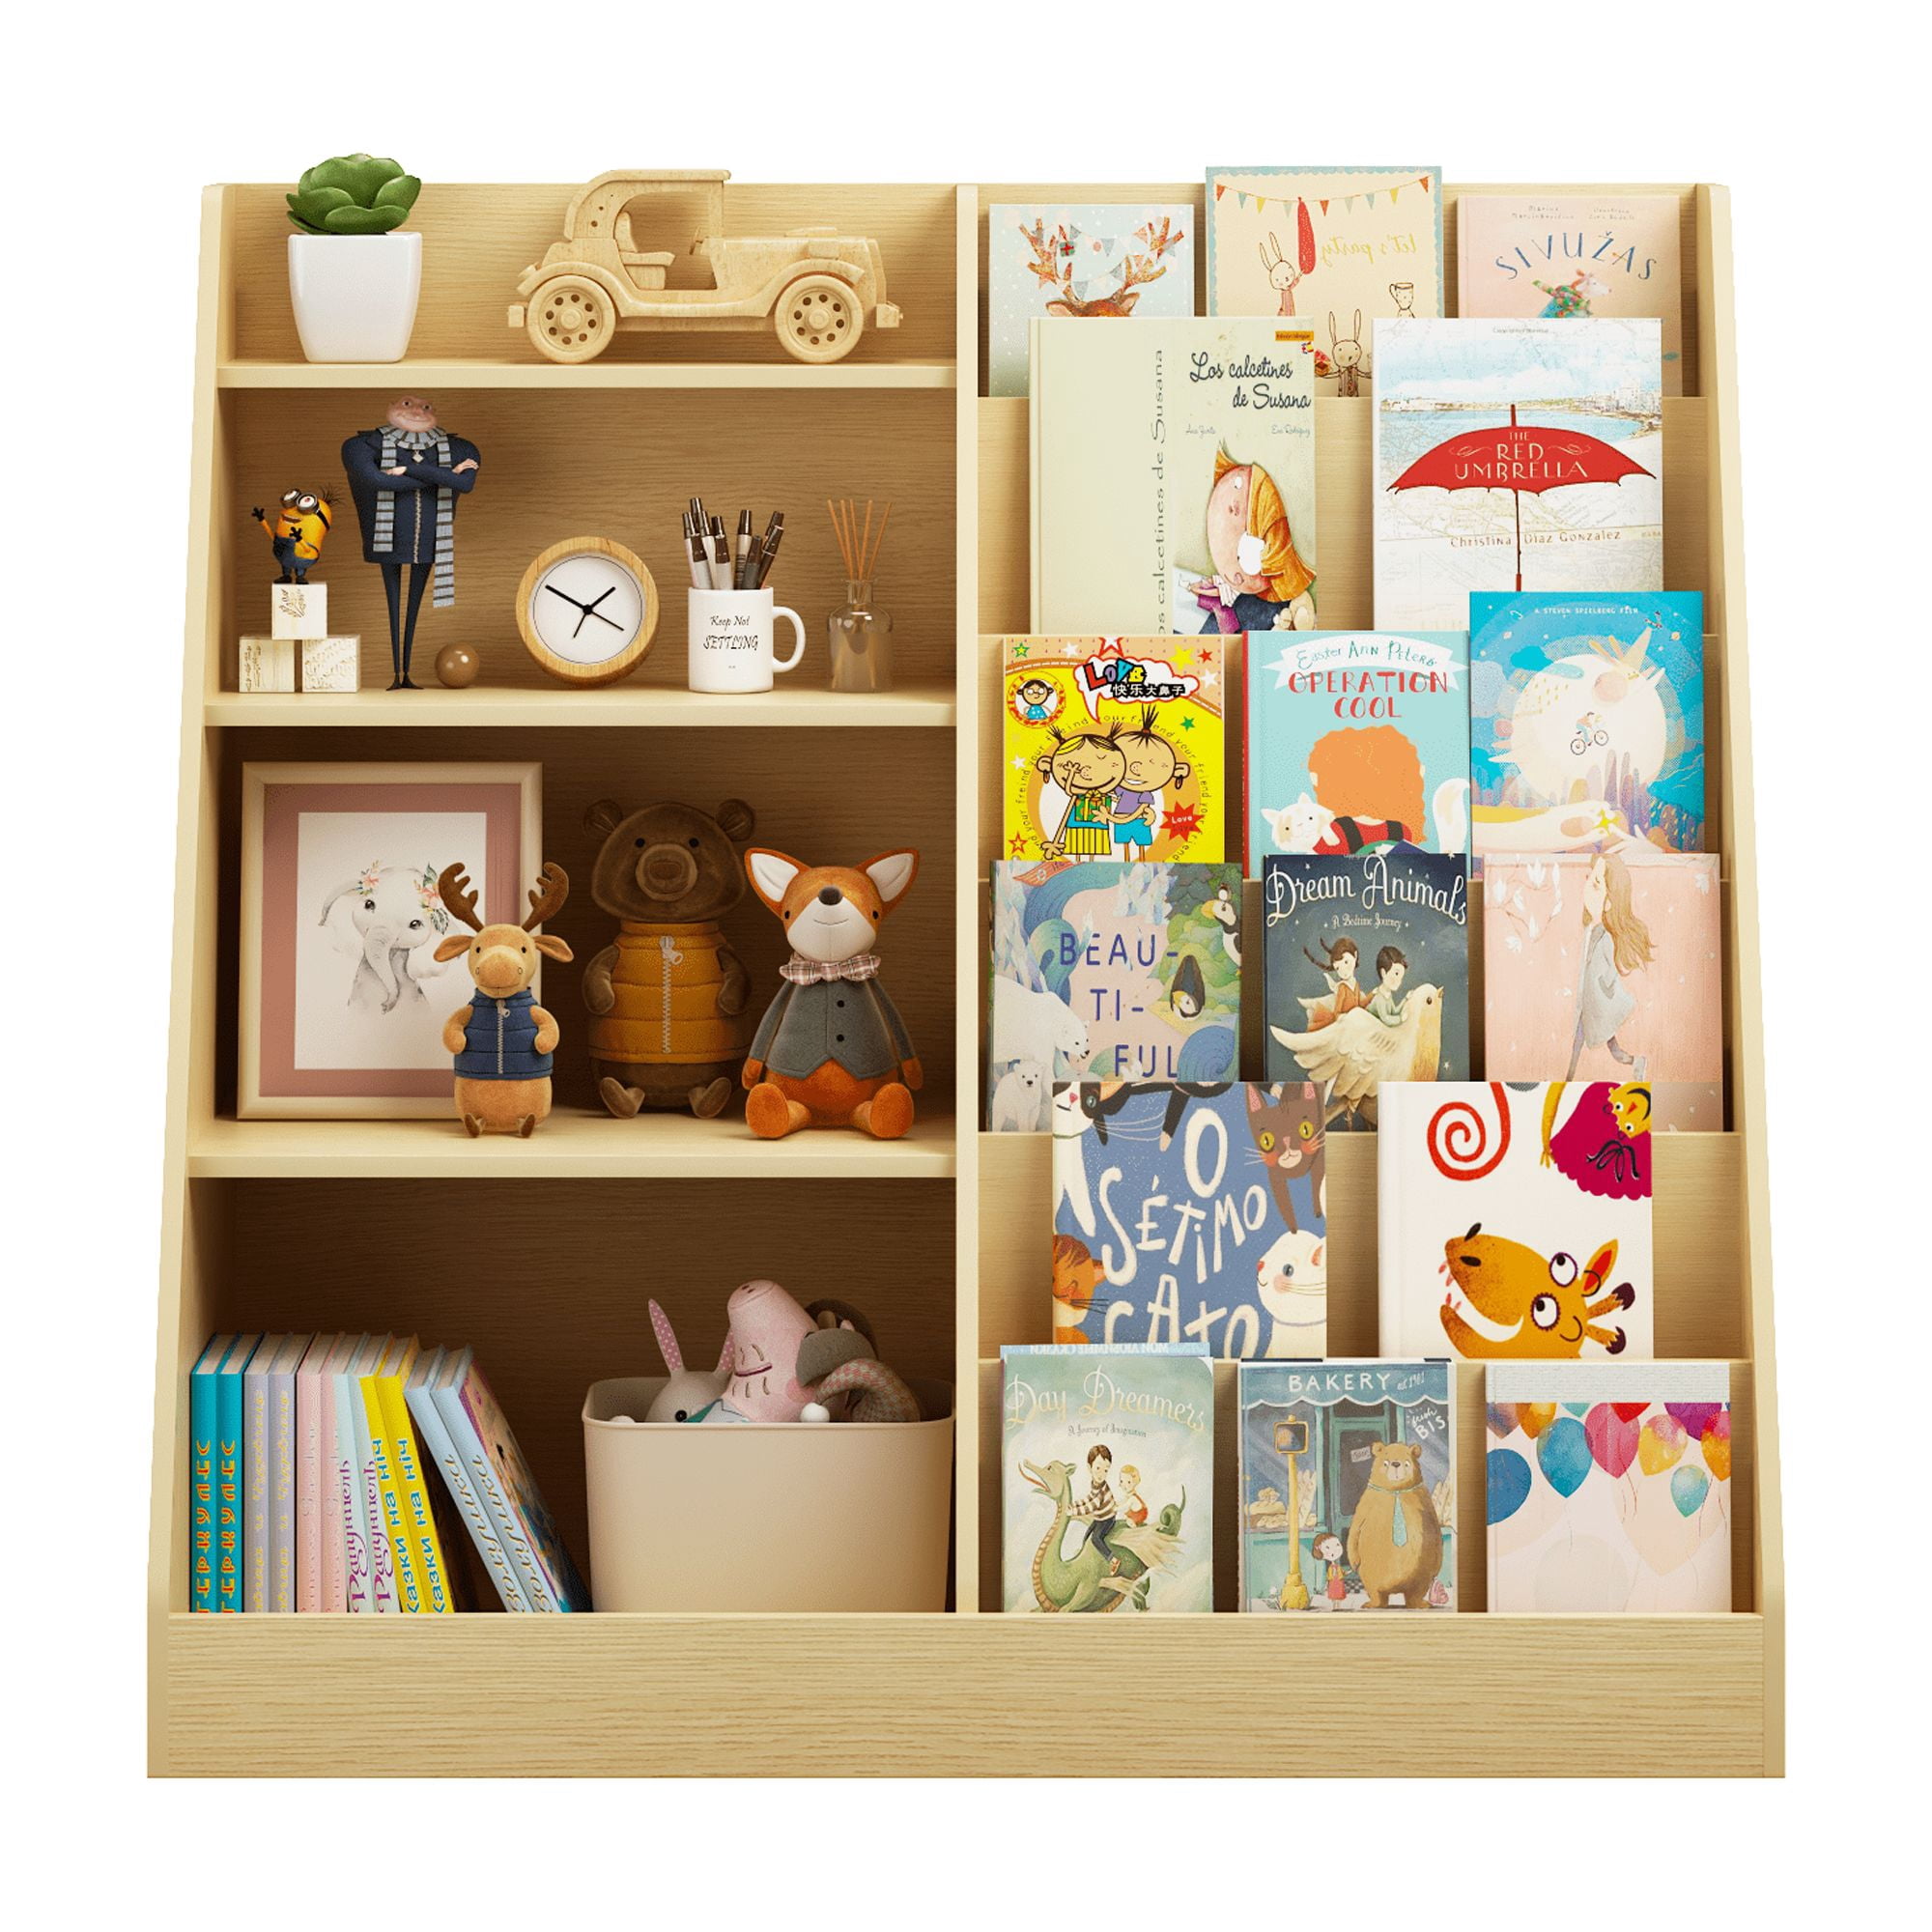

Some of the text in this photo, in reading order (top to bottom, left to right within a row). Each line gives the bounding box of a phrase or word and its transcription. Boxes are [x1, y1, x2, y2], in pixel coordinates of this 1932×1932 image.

[1495, 231, 1657, 280] SIVUŽAS
[1190, 352, 1293, 383] Los calcetines
[1151, 350, 1166, 444] Susana
[1233, 384, 1311, 410] de Susana
[1509, 432, 1530, 440] THE
[1151, 452, 1163, 479] de
[1497, 443, 1544, 461] RED
[1455, 461, 1588, 482] UMBRELLA
[1152, 488, 1165, 605] calcetines
[1451, 537, 1512, 548] Christina
[1559, 530, 1621, 543] Gonzalez
[710, 614, 750, 630] Keep Not
[702, 635, 758, 651] SETTLING
[1114, 682, 1185, 697] 快乐大鼻子
[1289, 671, 1448, 694] OPERATION
[1334, 696, 1404, 719] COOL
[1172, 815, 1193, 824] Love
[1266, 853, 1466, 927] Dream Animals
[1332, 913, 1402, 931] A Bedtime Journey
[1060, 933, 1179, 968] BEAU-
[1090, 989, 1144, 1021] TI-
[1115, 1044, 1178, 1078] FUL
[1184, 1108, 1228, 1198] O
[1289, 1373, 1391, 1392] BAKERY
[1006, 1364, 1206, 1433] Day Dreamers
[1102, 1423, 1109, 1433] of
[372, 1439, 389, 1480] ніч
[398, 1439, 415, 1480] ніч
[384, 1492, 401, 1525] на
[411, 1492, 426, 1525] на
